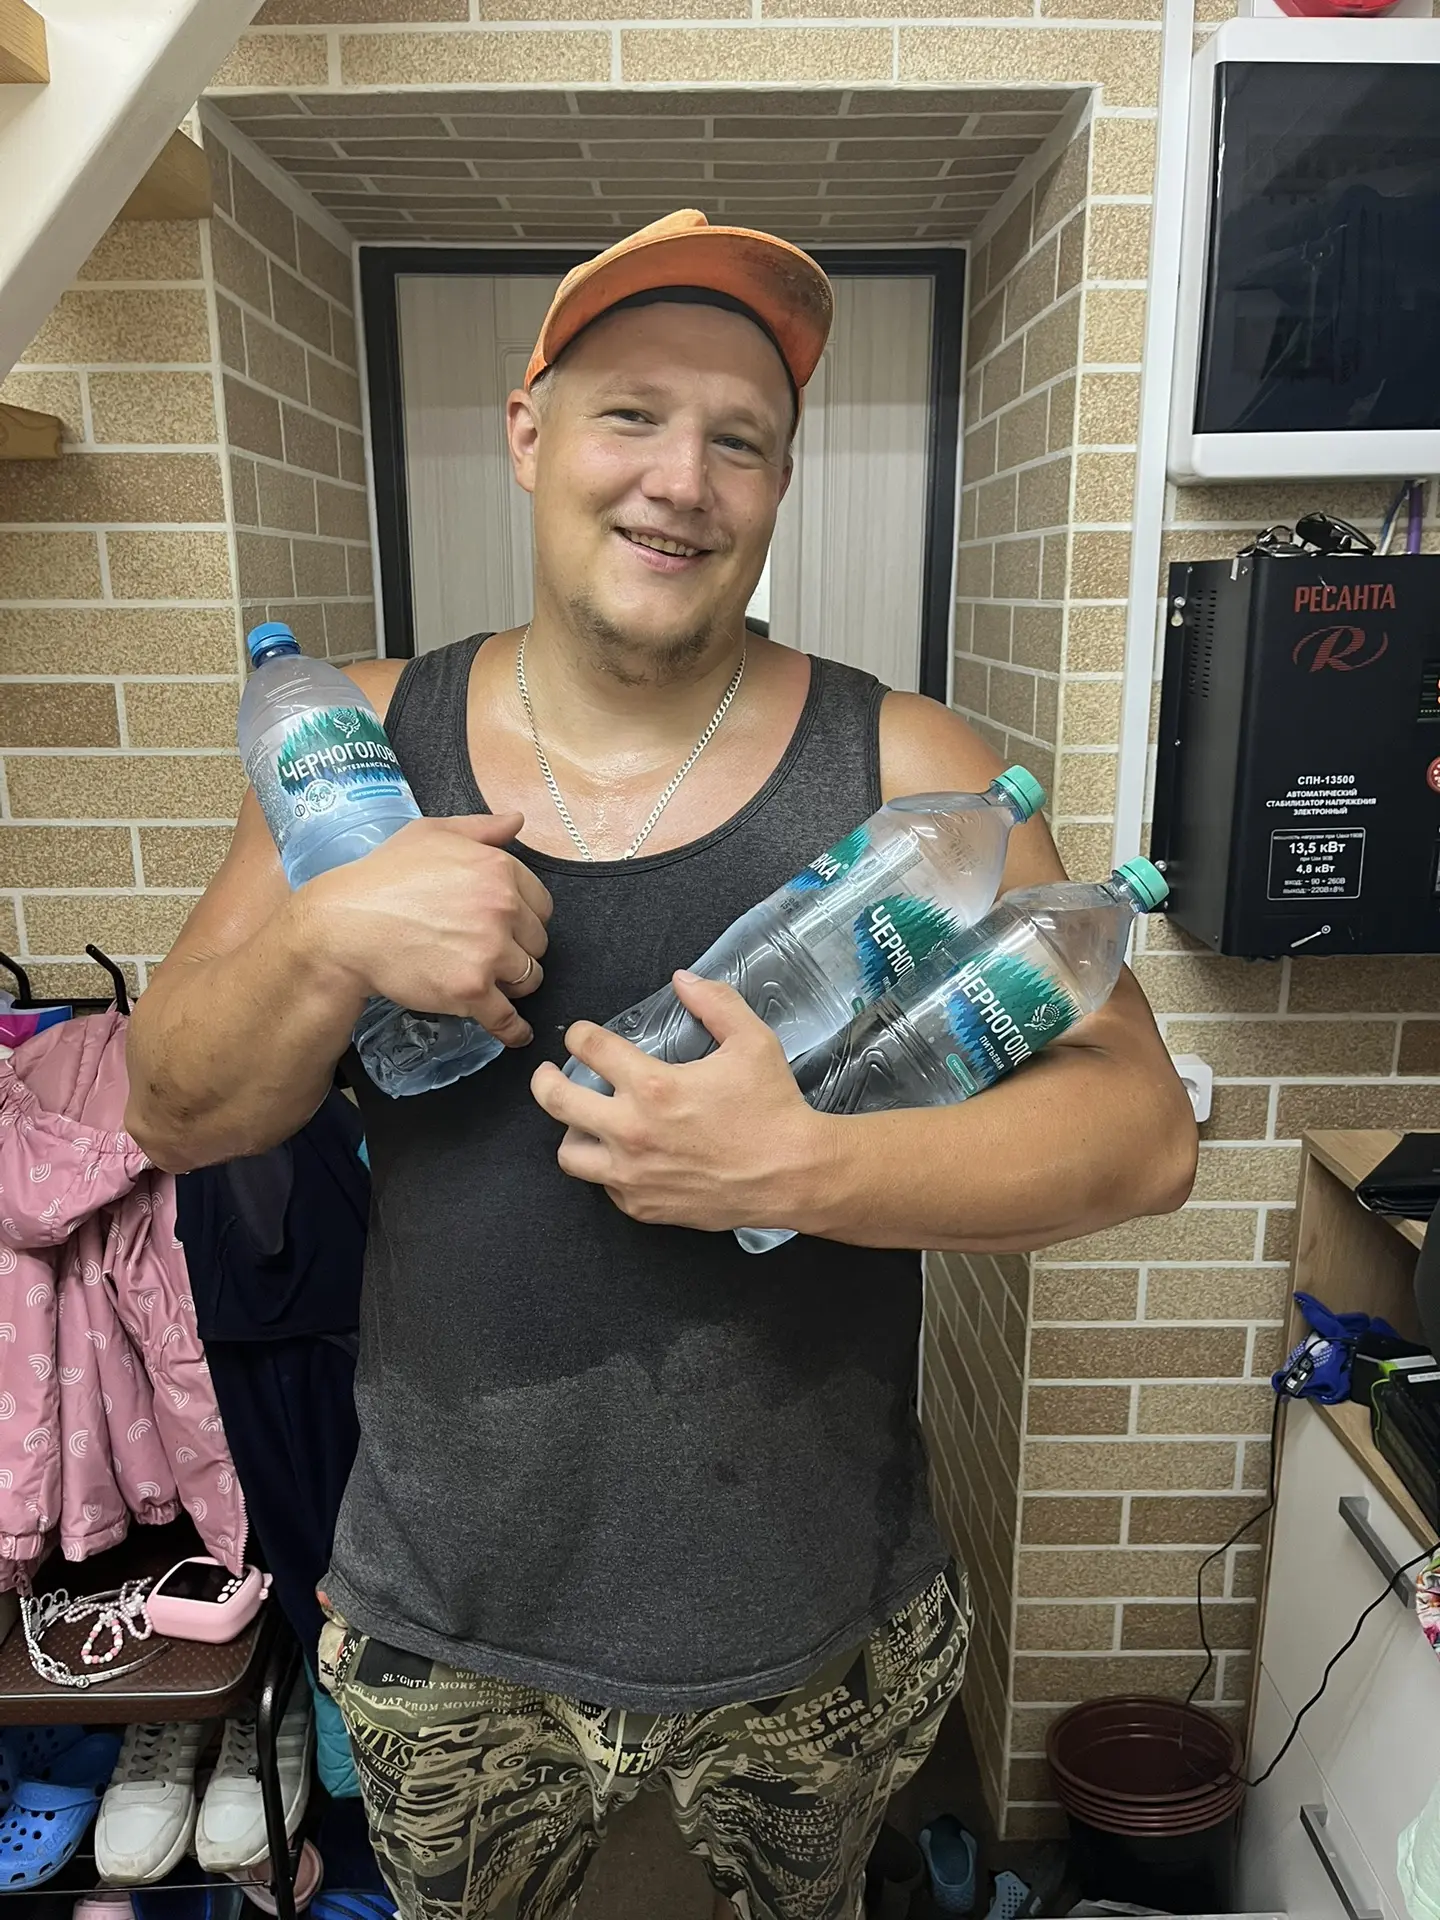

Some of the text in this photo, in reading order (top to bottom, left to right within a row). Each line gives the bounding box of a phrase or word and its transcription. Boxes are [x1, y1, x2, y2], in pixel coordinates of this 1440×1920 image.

[1294, 583, 1396, 613] РЕСАНТА
[1297, 774, 1355, 785] СПН-13500
[1286, 788, 1358, 798] АВТОМАТИЧЕСКИЙ
[1266, 798, 1377, 808] СТАБИЛИЗАТОР НАПРЯЖЕНИЯ
[1293, 807, 1348, 816] ЭЛЕКТРОННЫЙ
[1289, 841, 1346, 856] 13,5 кВт
[1296, 863, 1336, 874] 4,8 кВт
[868, 904, 916, 977] ЧЕРНОГ
[978, 1035, 1005, 1071] ПИТЬЕВАЯ
[439, 1682, 477, 1690] MORE
[477, 1689, 513, 1700] THAN
[404, 1700, 439, 1712] FROM
[442, 1699, 494, 1711] MOVING
[499, 1699, 512, 1709] IN
[492, 1706, 509, 1715] OF
[744, 1685, 850, 1730] KEY XS23
[752, 1718, 826, 1747] RULES
[826, 1699, 866, 1726] FOR
[786, 1703, 884, 1762] SKIPPERS
